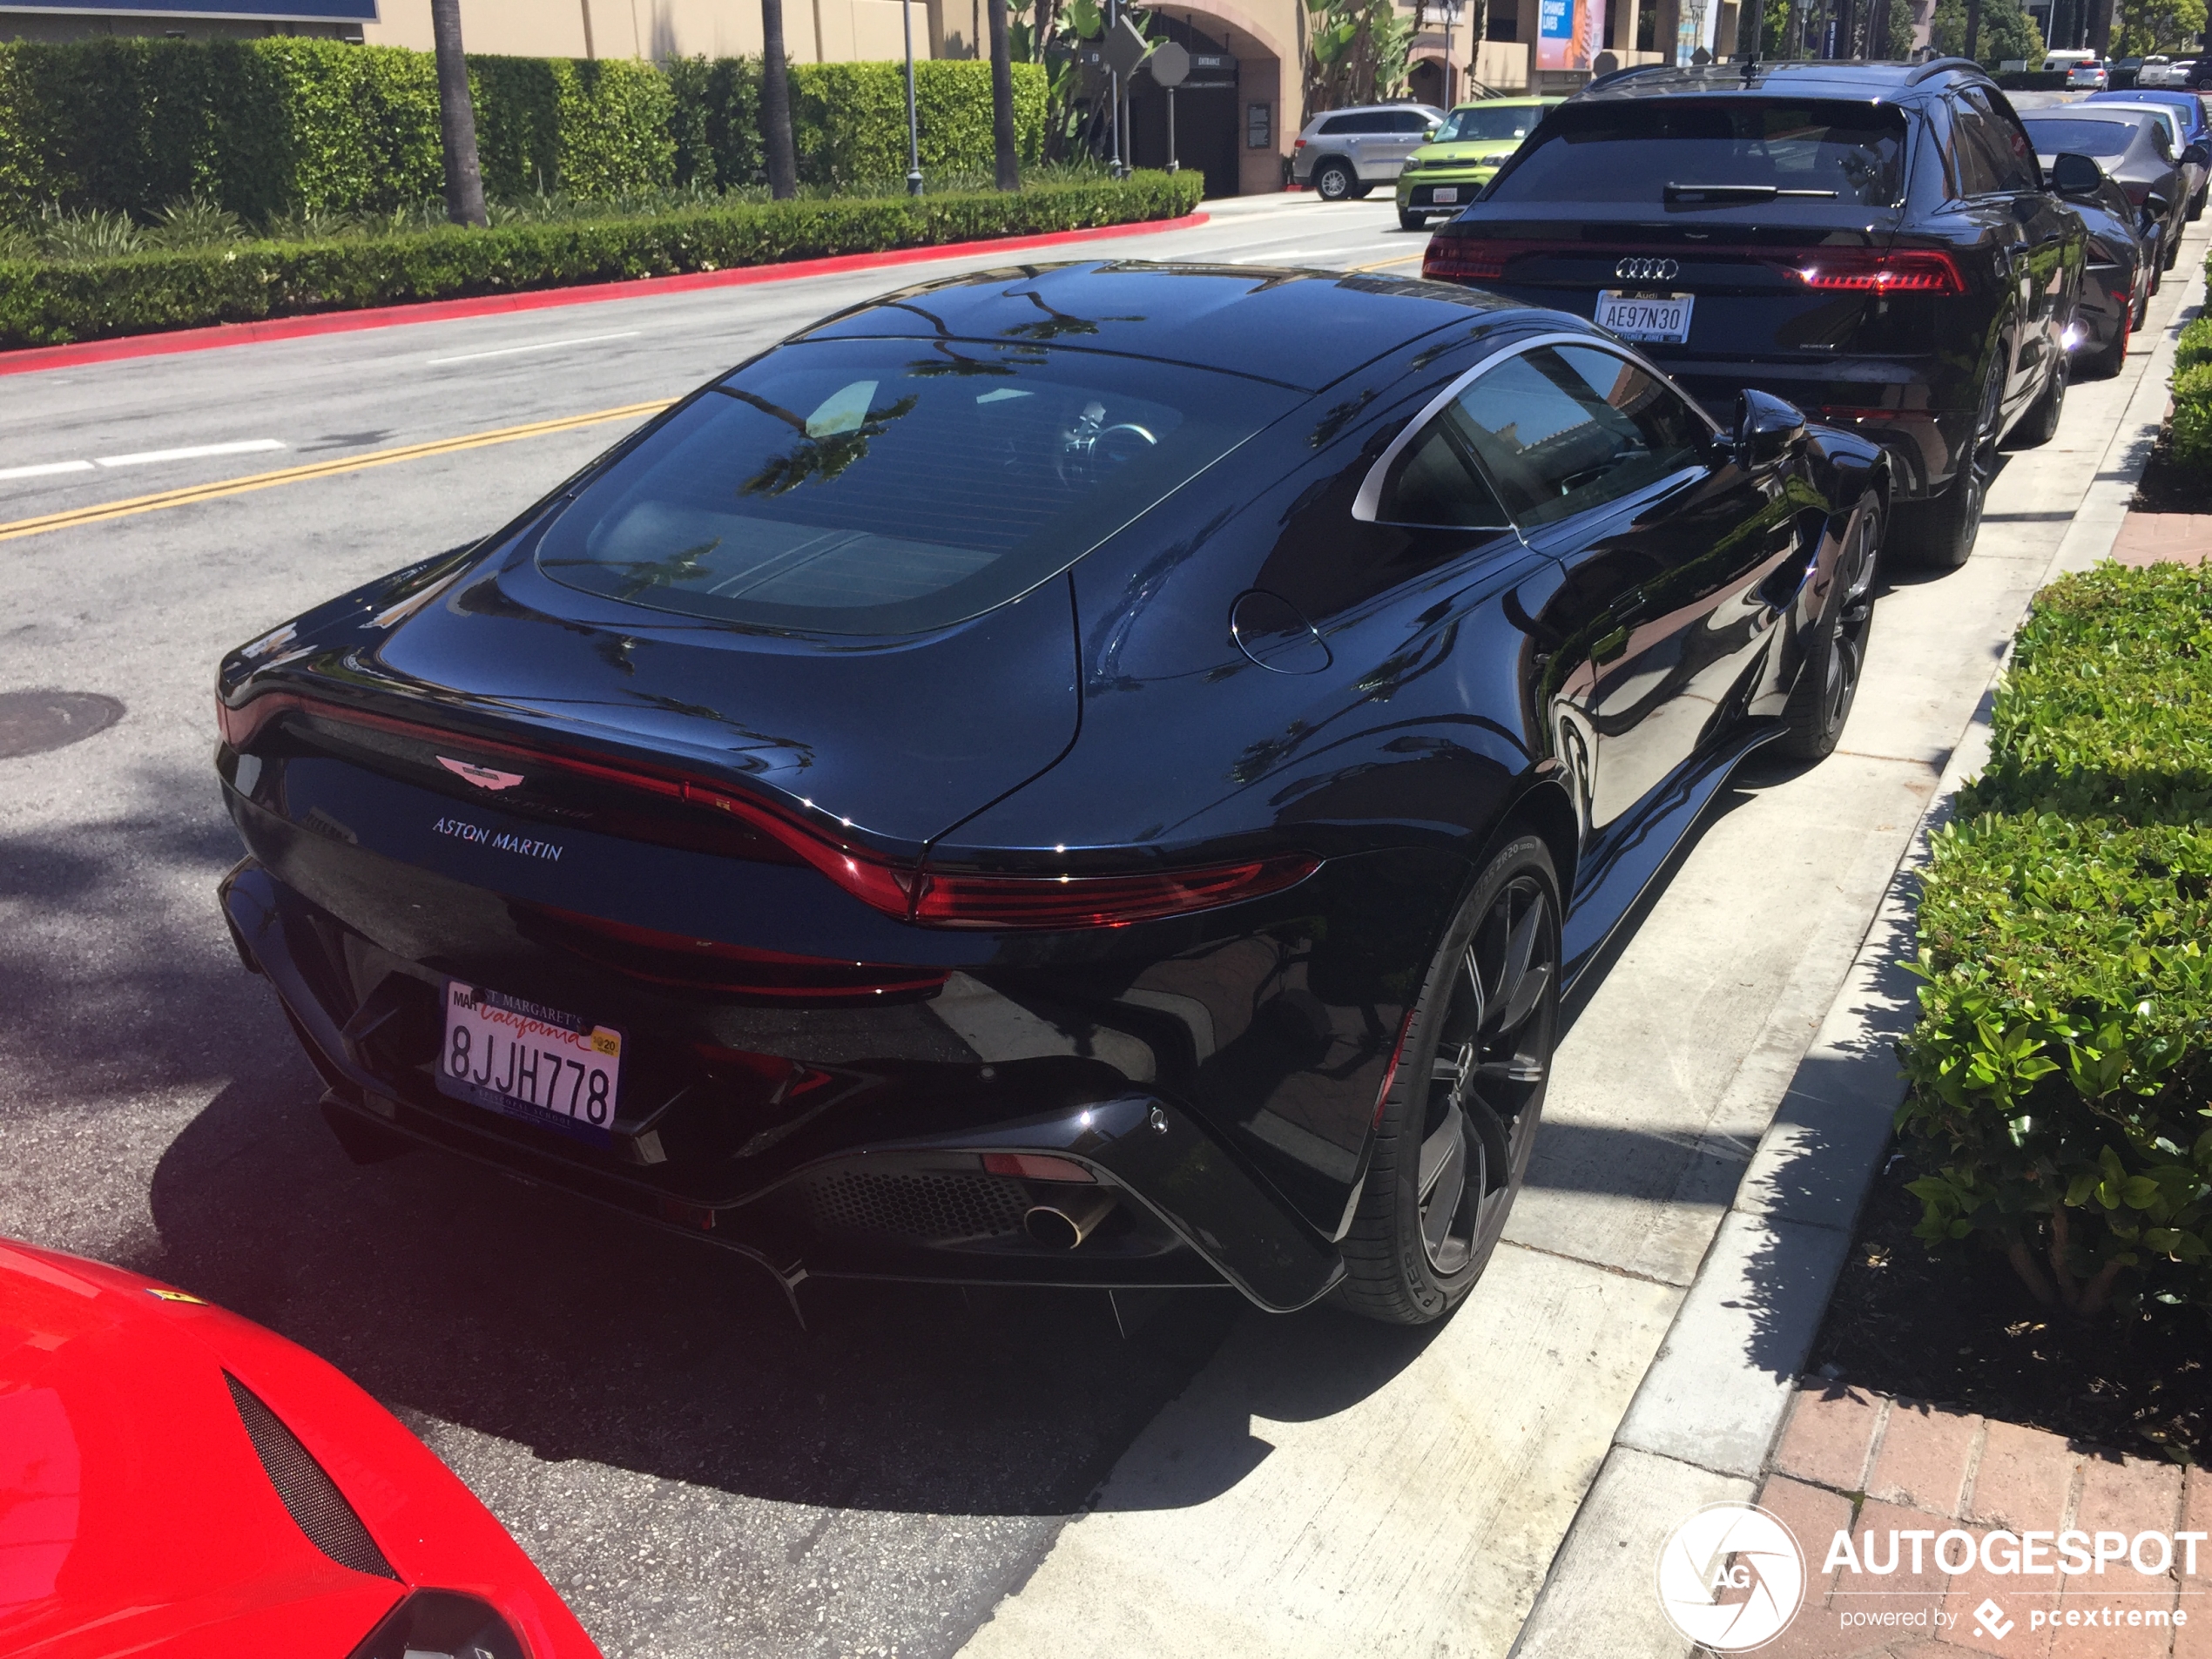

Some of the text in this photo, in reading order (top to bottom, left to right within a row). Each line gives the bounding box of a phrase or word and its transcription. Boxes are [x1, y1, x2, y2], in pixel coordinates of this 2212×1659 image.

[1544, 1, 1566, 16] CHANGE
[1542, 16, 1558, 30] LIVES
[1198, 57, 1221, 66] ENTRANCE
[1606, 306, 1681, 330] AE97N30
[433, 817, 563, 862] ASTON MARTIN
[1495, 844, 1519, 872] ZR20
[454, 991, 477, 1012] MAR
[502, 994, 583, 1025] MARGARET'S
[604, 1039, 616, 1051] 20
[451, 1025, 610, 1125] 8JJH778
